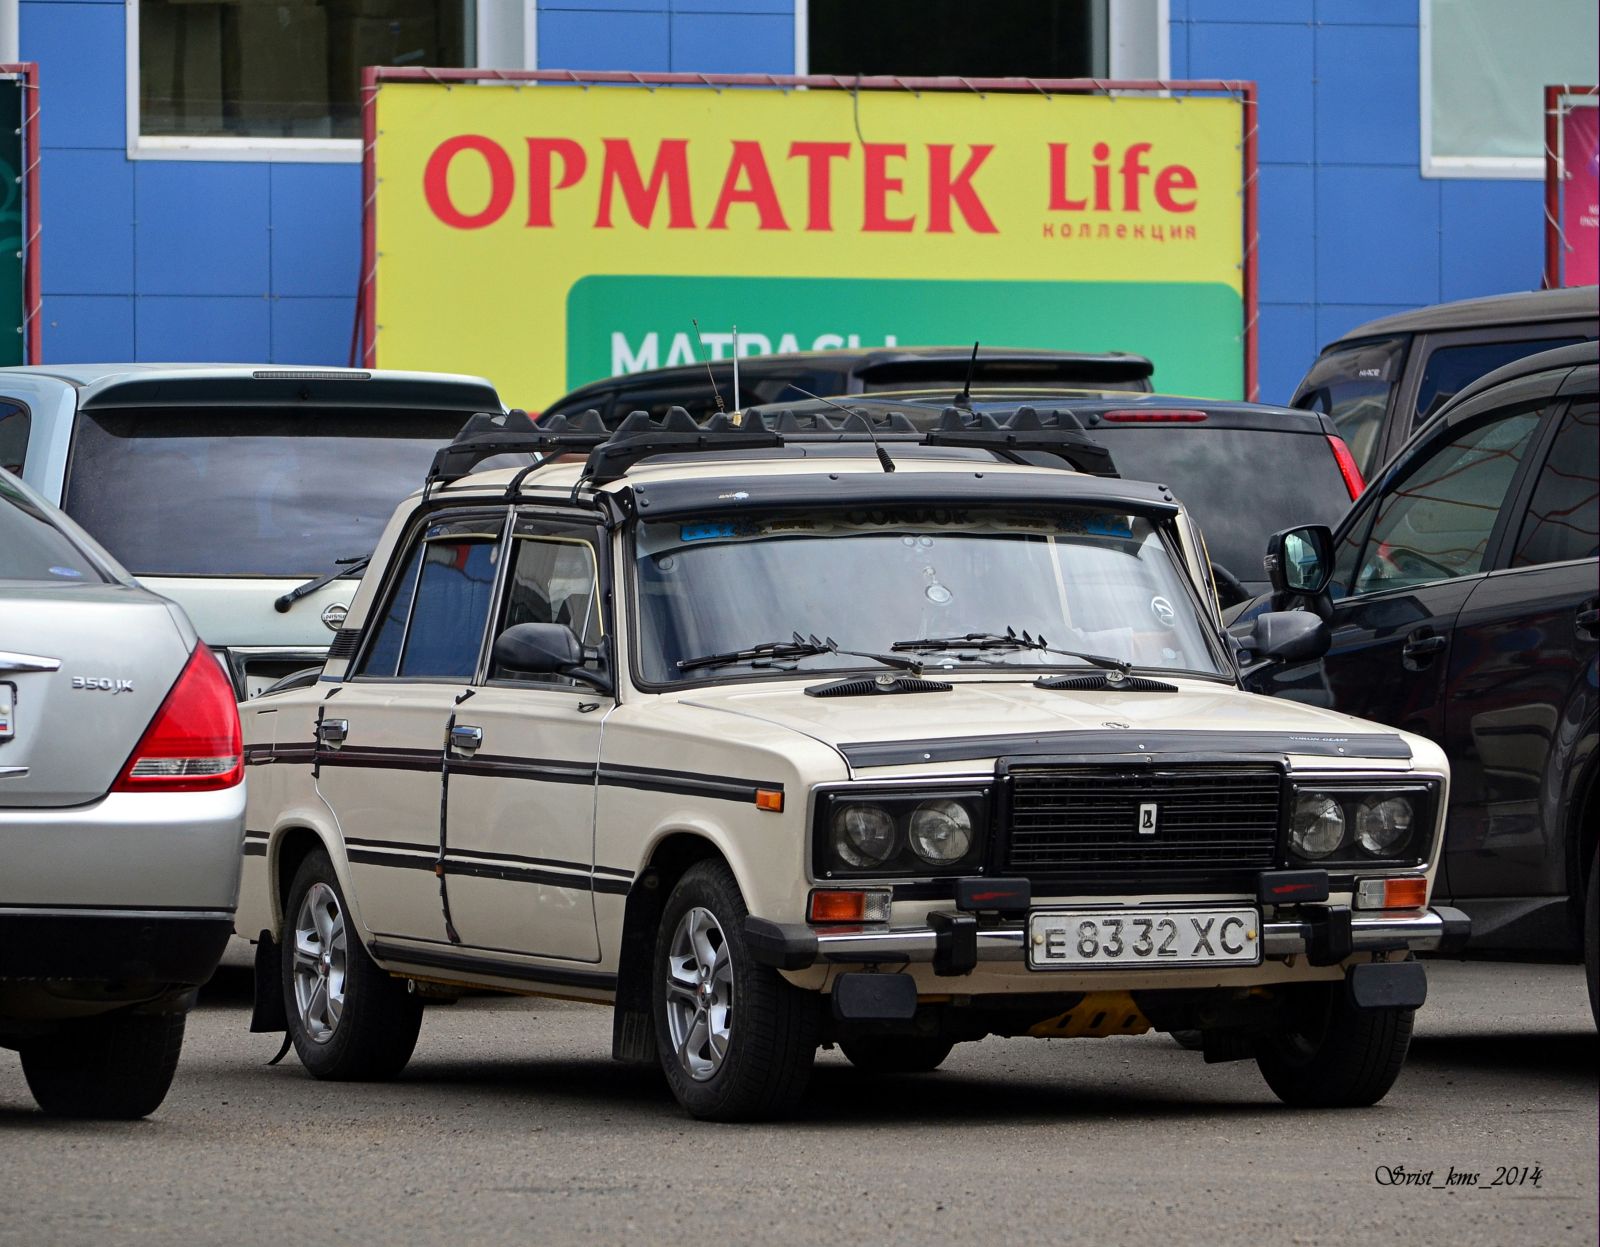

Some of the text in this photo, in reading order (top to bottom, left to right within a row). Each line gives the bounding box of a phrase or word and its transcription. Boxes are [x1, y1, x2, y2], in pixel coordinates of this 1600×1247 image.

[423, 134, 998, 234] ОРМАТЕК
[1049, 142, 1197, 213] Life
[1042, 223, 1197, 241] коллекция
[1076, 917, 1178, 958] 8332
